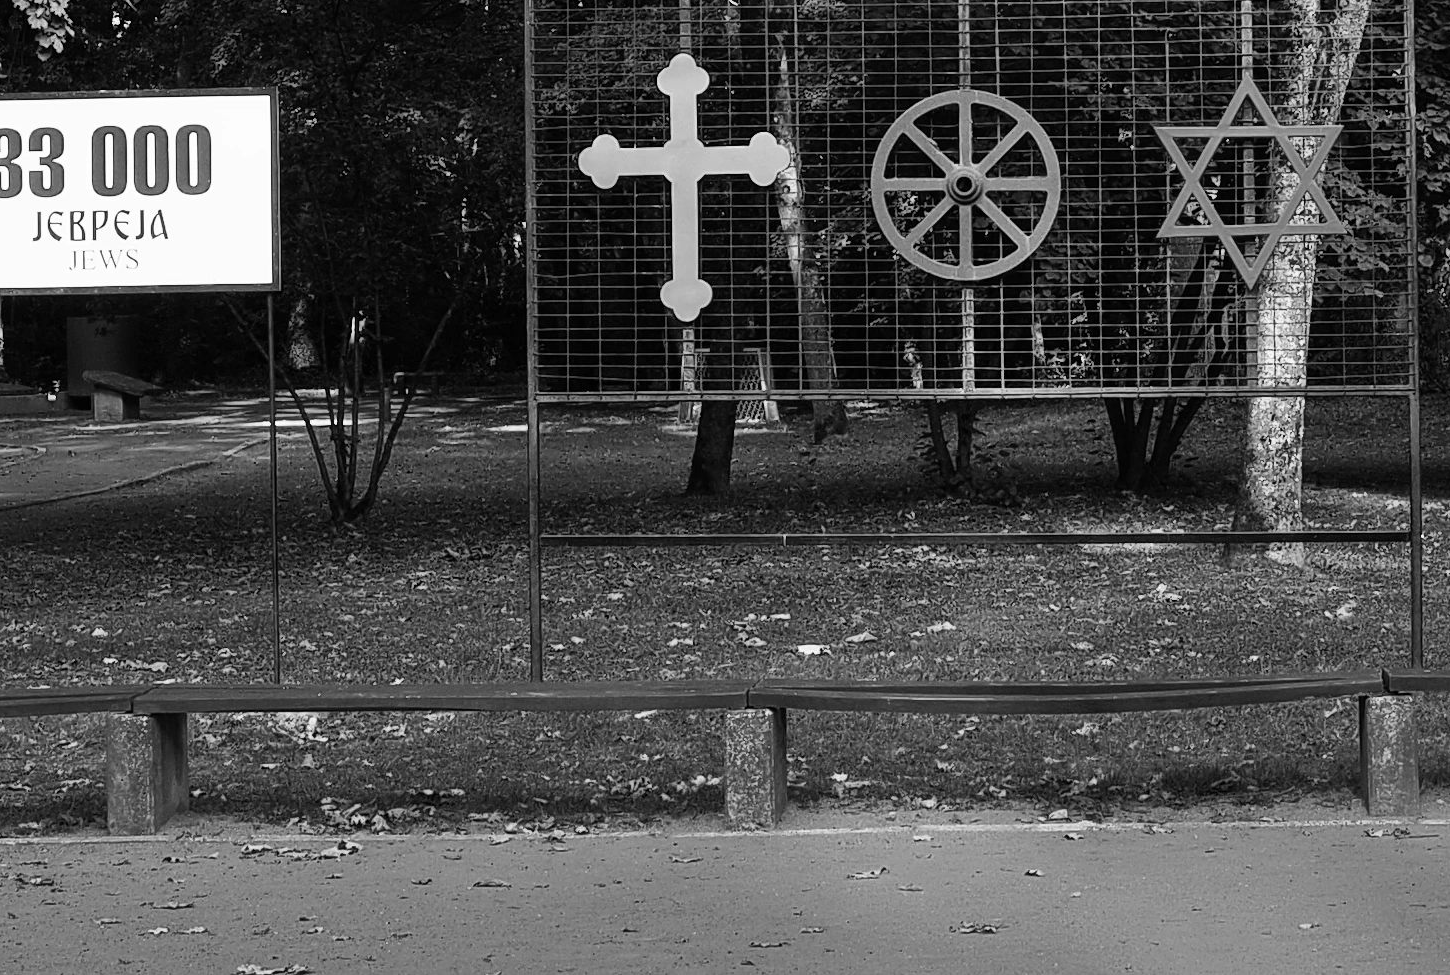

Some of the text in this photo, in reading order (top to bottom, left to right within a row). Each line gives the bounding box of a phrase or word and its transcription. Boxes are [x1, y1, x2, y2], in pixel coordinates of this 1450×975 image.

[91, 124, 212, 197] 000
[32, 209, 169, 242] ЈЕВРЕЈА
[69, 249, 138, 271] JEWS
